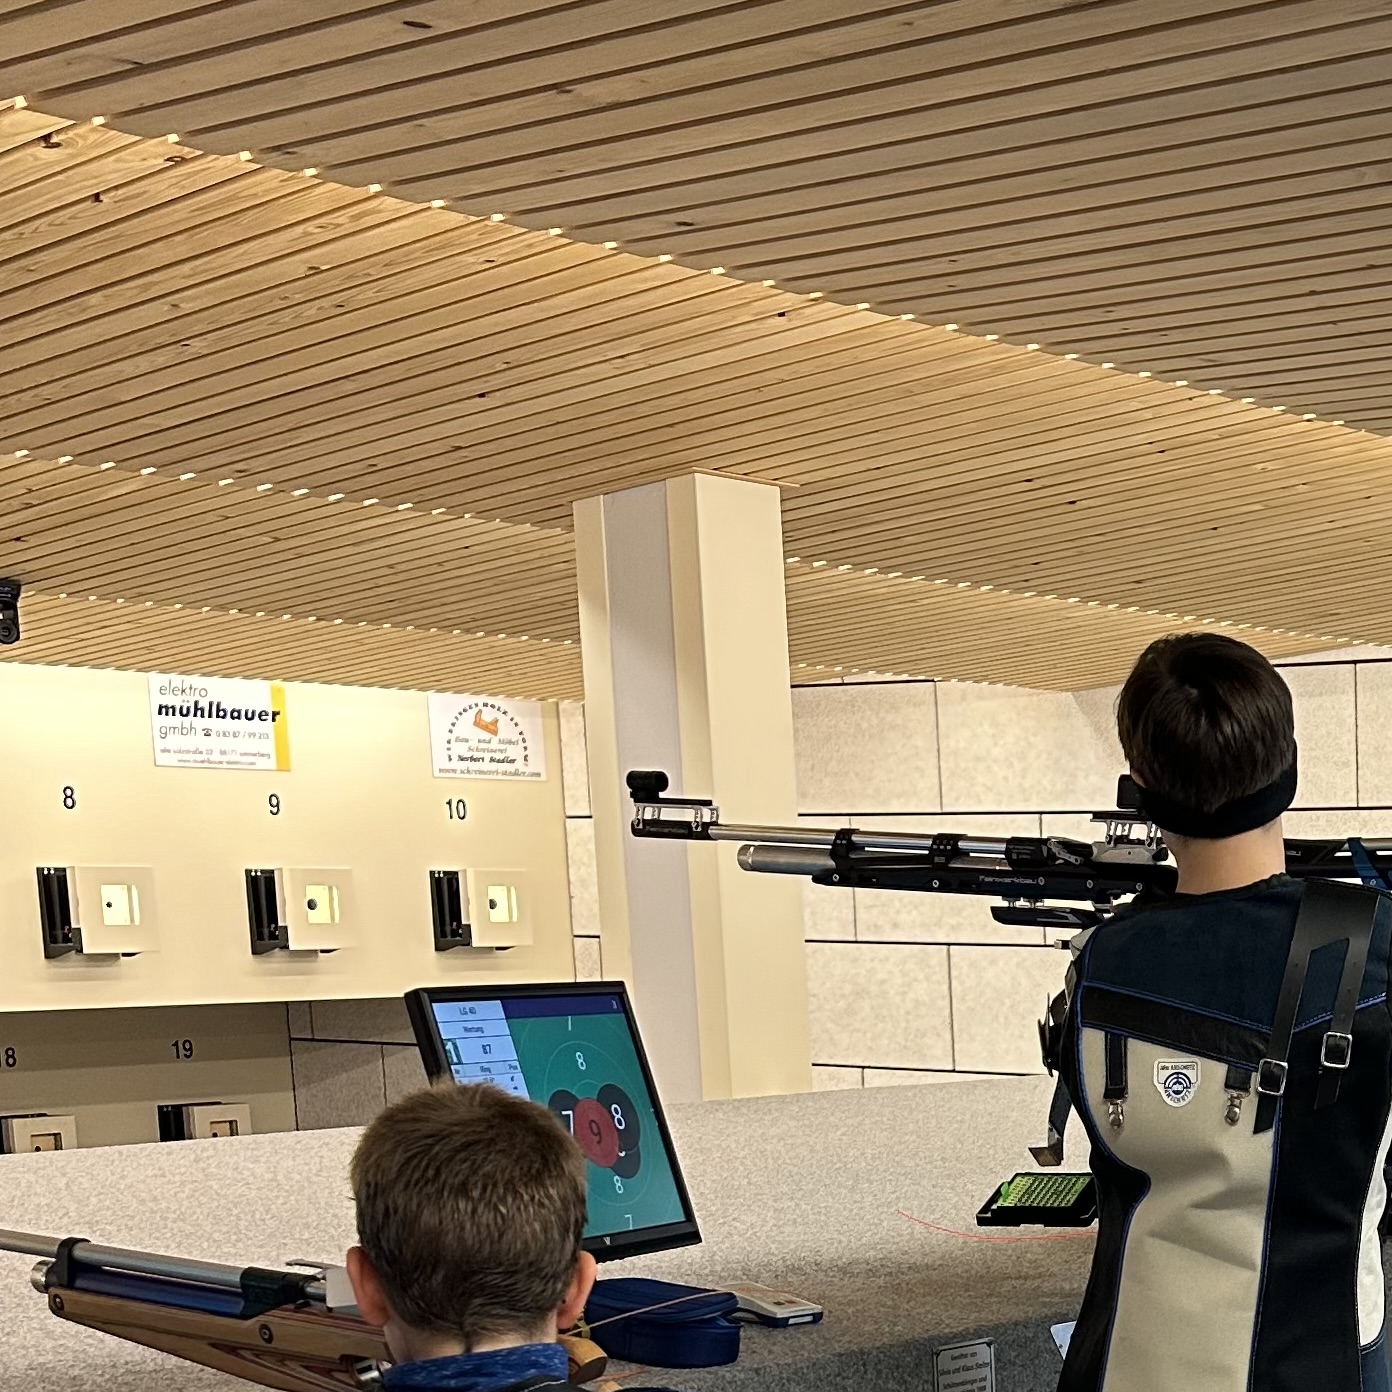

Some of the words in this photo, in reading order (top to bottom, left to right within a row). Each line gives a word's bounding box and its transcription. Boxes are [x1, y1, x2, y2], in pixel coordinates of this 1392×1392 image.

[159, 679, 208, 698] elektro
[157, 699, 281, 722] mühlbauer
[159, 720, 197, 739] gmbh
[489, 755, 517, 764] Stadler
[63, 786, 76, 809] 8
[268, 793, 280, 816] 9
[446, 798, 467, 820] 10
[0, 1047, 17, 1067] 8
[171, 1039, 194, 1059] 19
[575, 1051, 587, 1071] 8
[611, 1103, 626, 1130] 8
[613, 1175, 624, 1194] 8
